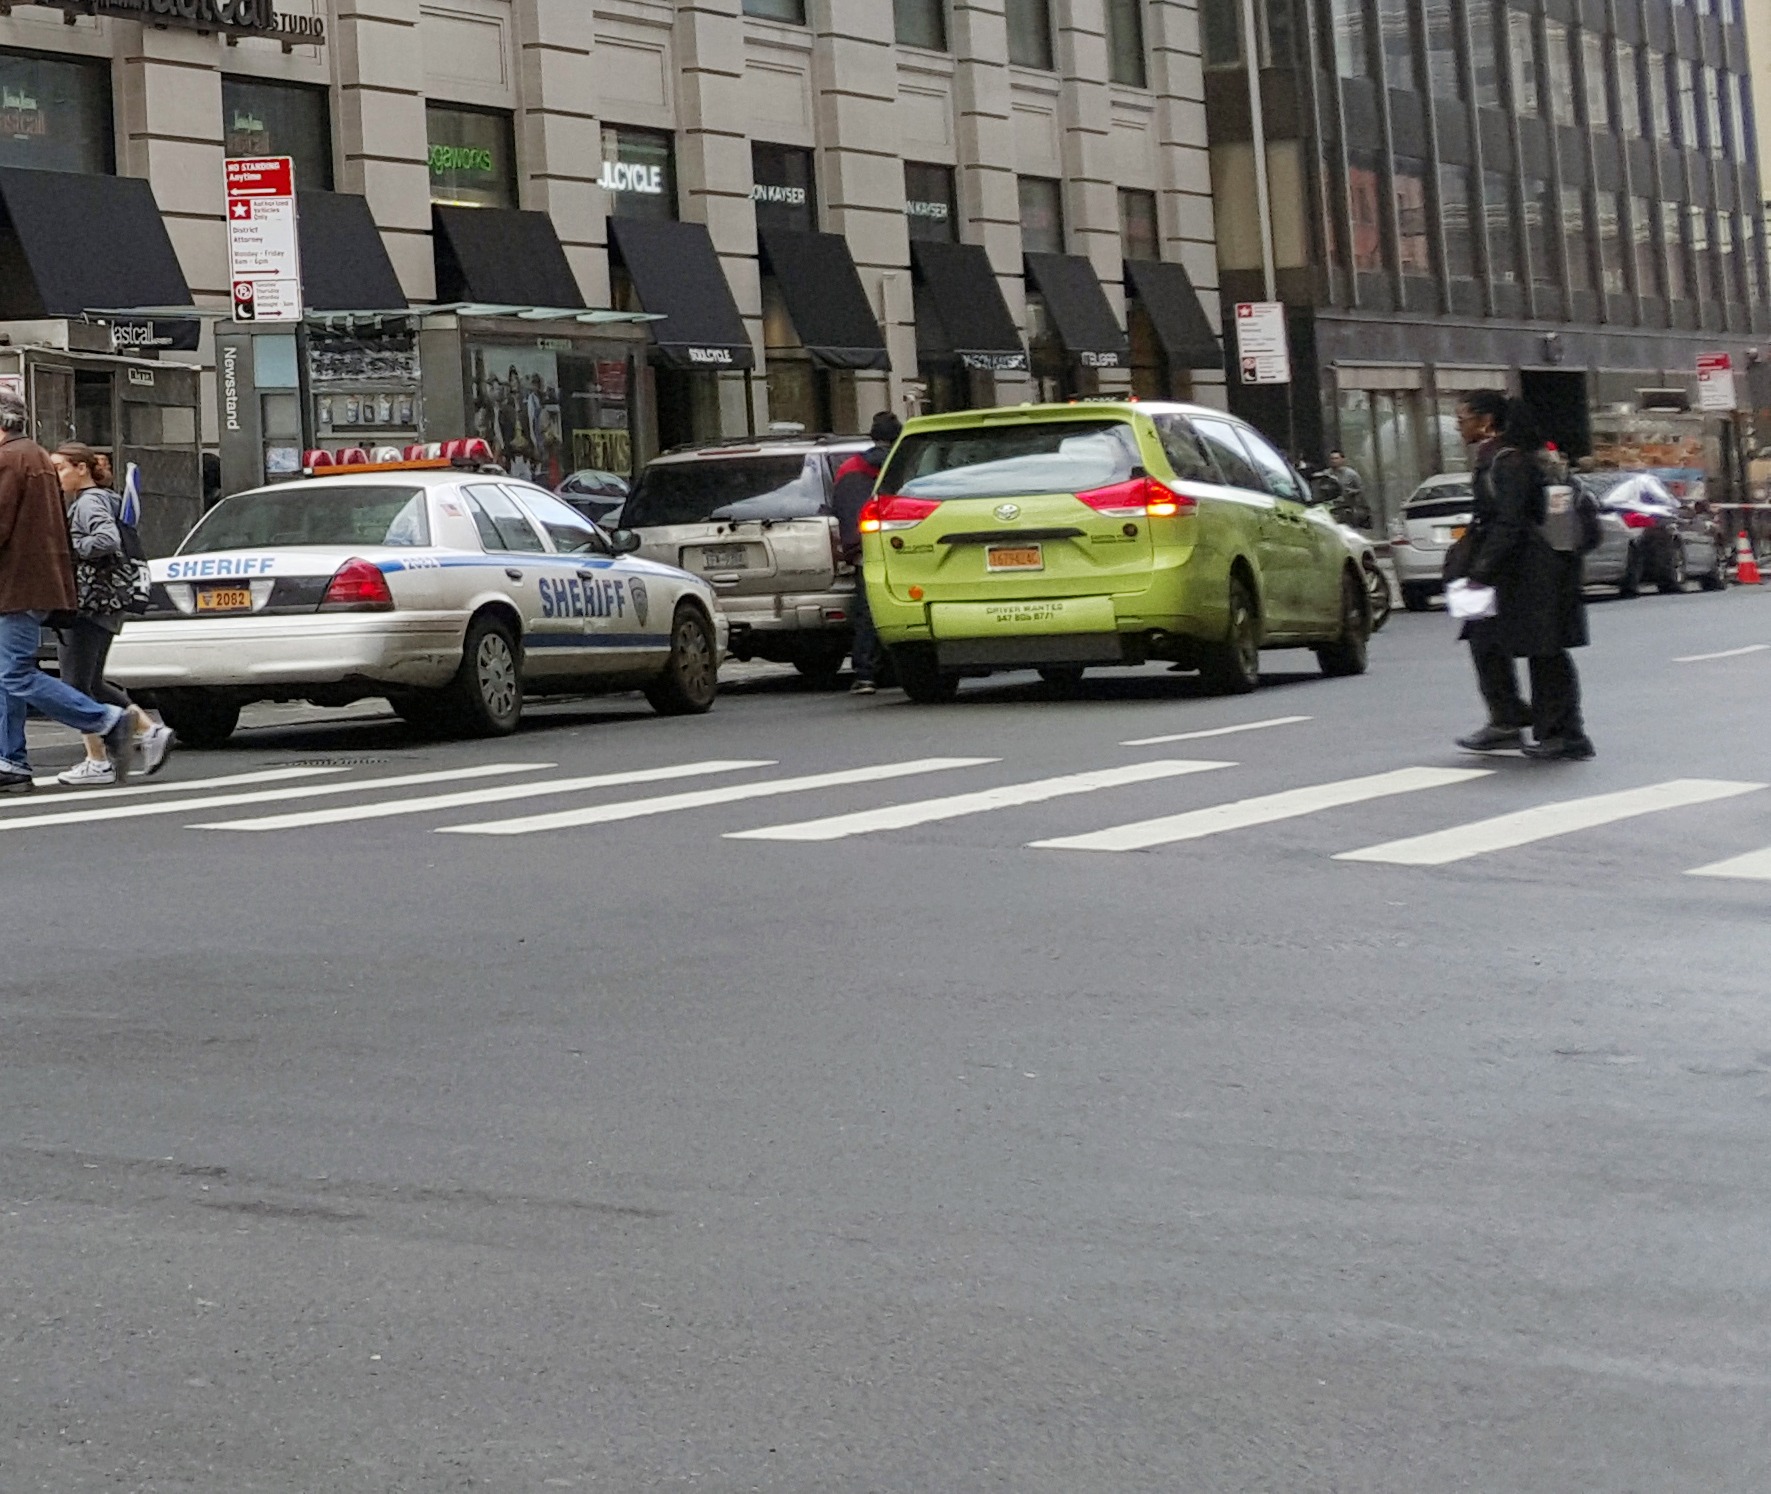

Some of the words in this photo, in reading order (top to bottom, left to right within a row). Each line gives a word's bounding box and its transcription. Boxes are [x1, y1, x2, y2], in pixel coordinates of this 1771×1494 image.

[272, 10, 324, 38] STUDIO
[228, 163, 240, 172] NO
[241, 162, 280, 171] STANDING
[427, 145, 492, 175] gaworks
[229, 173, 262, 182] Anytime
[768, 186, 806, 205] KAYSER
[111, 319, 154, 345] lastcall
[223, 347, 240, 430] Newsstand
[167, 557, 275, 579] SHERIFF
[216, 592, 245, 606] 2082
[539, 576, 626, 619] SHERIFF
